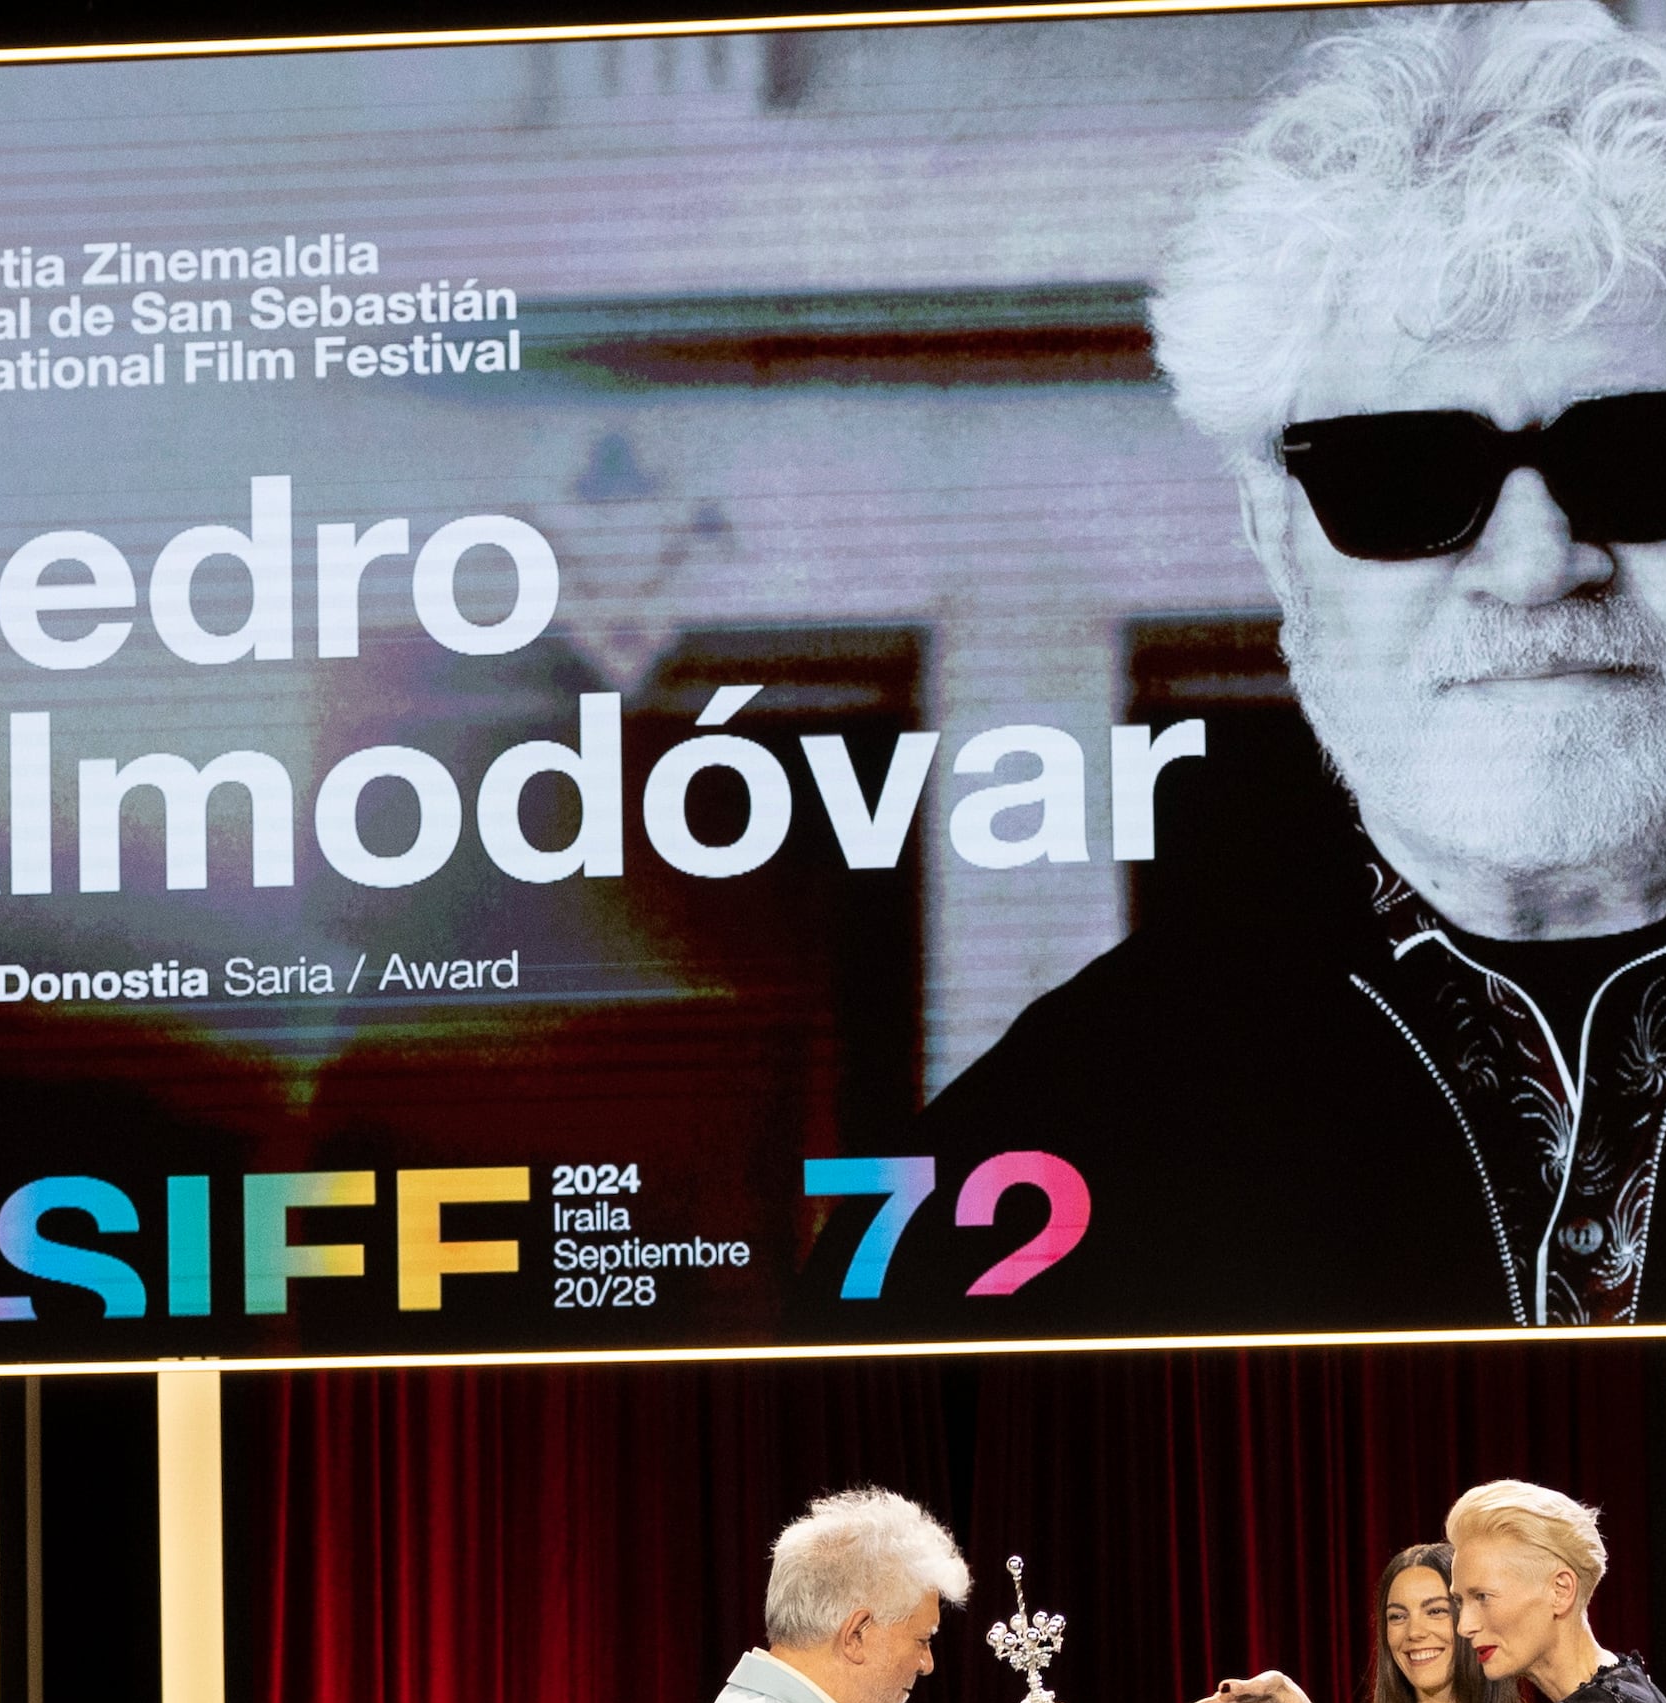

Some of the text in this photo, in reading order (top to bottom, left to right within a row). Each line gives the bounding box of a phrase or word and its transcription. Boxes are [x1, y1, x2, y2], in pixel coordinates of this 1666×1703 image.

[82, 234, 379, 284] Zinemaldia
[49, 296, 115, 337] de
[131, 291, 232, 334] San
[250, 280, 517, 330] Sebastián
[185, 340, 295, 384] Film
[315, 330, 520, 379] Festival
[224, 956, 335, 996] Saria
[346, 954, 367, 993] /
[379, 949, 520, 991] Award
[552, 1163, 642, 1196] 2024
[553, 1200, 632, 1232] Iraila
[802, 1150, 1093, 1300] 72
[553, 1235, 751, 1275] Septiembre
[553, 1274, 657, 1308] 20/28
